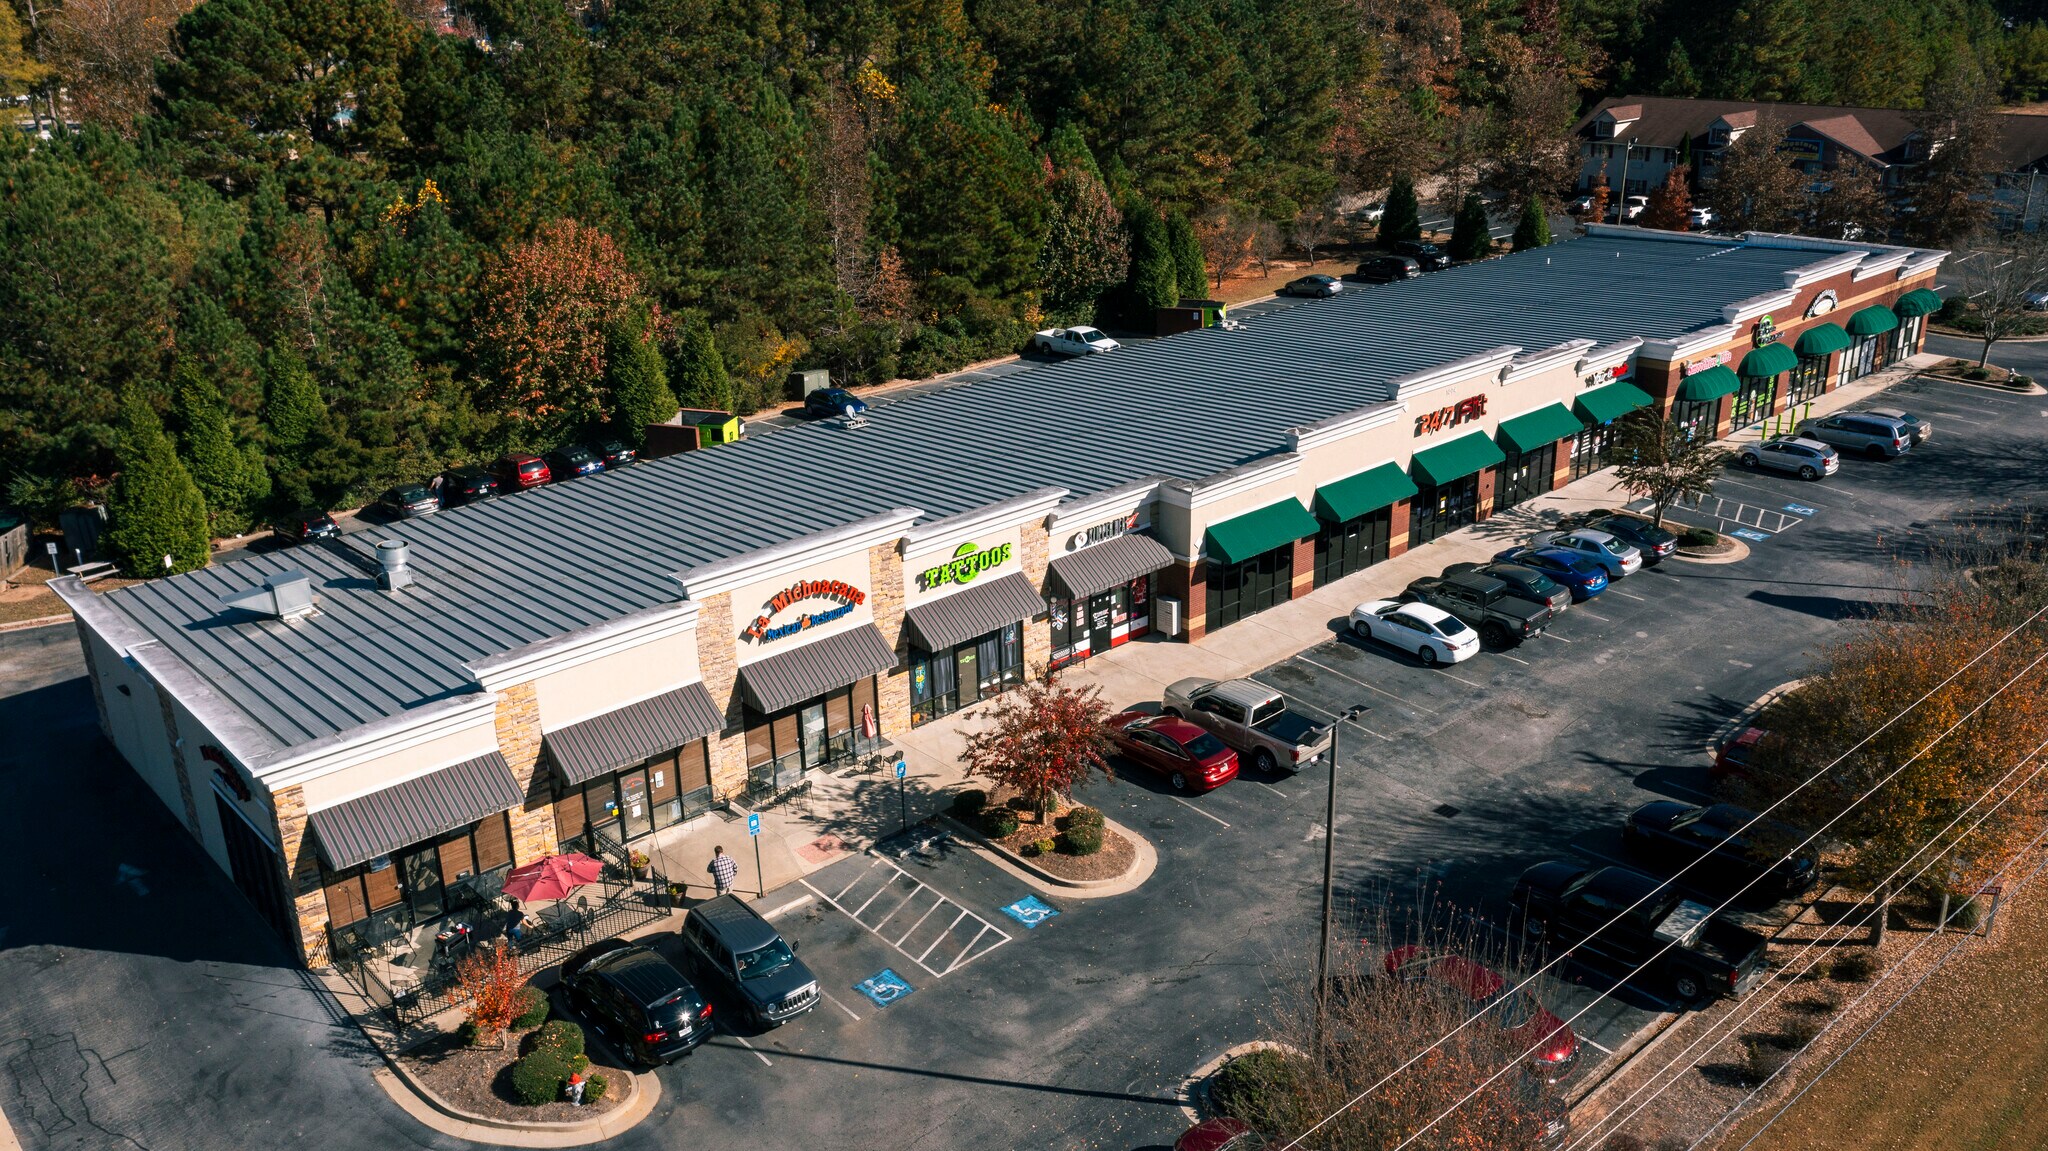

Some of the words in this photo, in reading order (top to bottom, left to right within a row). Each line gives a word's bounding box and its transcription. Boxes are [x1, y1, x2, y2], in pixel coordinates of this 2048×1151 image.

[1421, 405, 1455, 433] 24/7
[1456, 393, 1488, 425] Fit
[925, 542, 1012, 588] TATTOOS
[747, 615, 771, 639] La
[771, 580, 866, 613] Michoacana
[766, 620, 803, 641] Mexican
[810, 603, 854, 627] Restaurant
